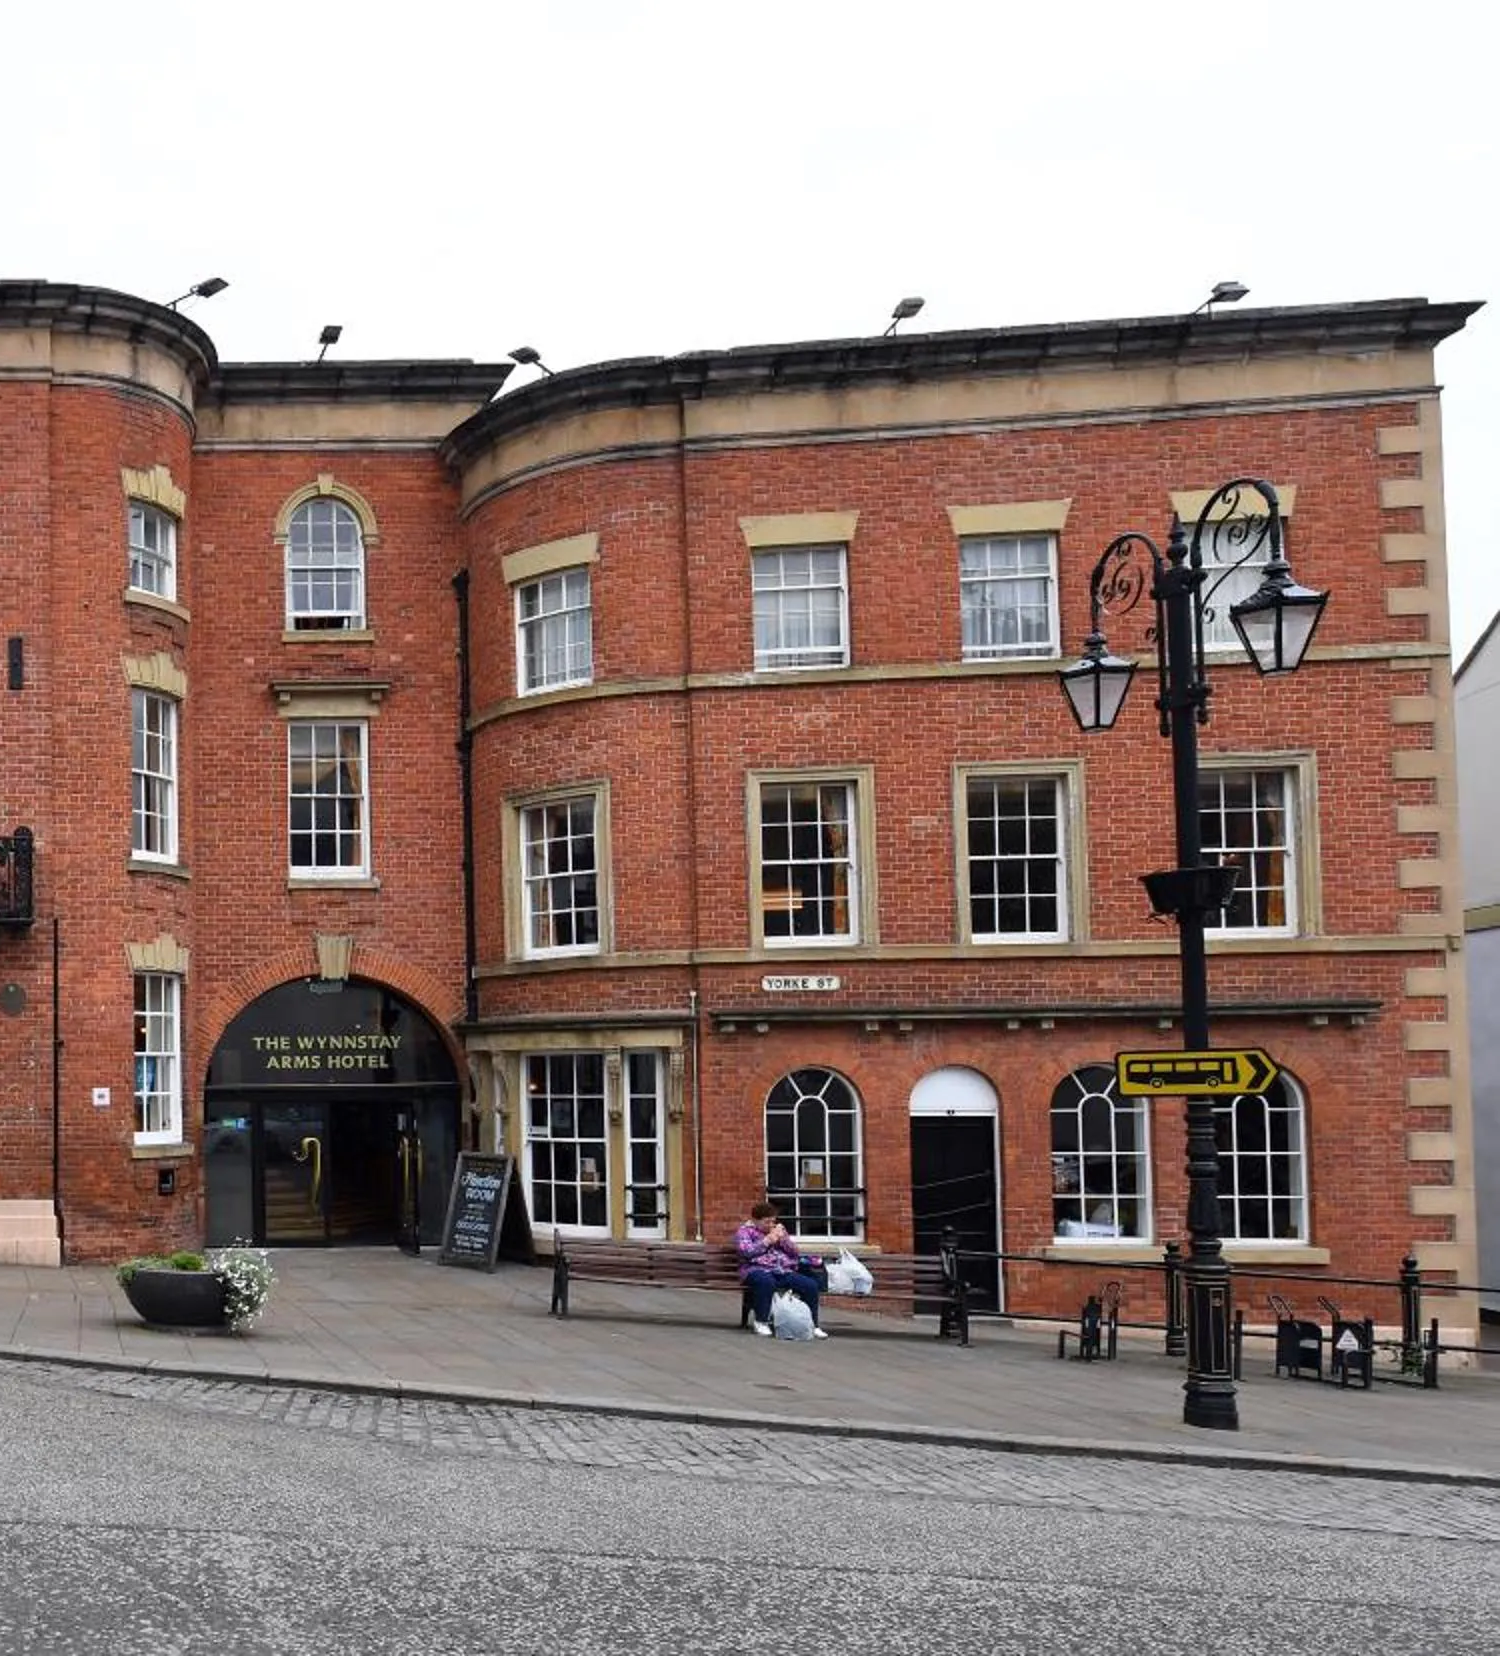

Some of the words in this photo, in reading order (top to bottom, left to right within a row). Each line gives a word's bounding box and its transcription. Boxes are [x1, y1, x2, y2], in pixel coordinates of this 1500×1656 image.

[767, 978, 809, 989] YORKE
[817, 978, 834, 988] ST
[252, 1036, 291, 1050] THE
[296, 1035, 401, 1049] WYNNSTAY
[266, 1055, 321, 1069] ARMS
[327, 1055, 389, 1068] HOTEL
[465, 1187, 496, 1201] ROOM
